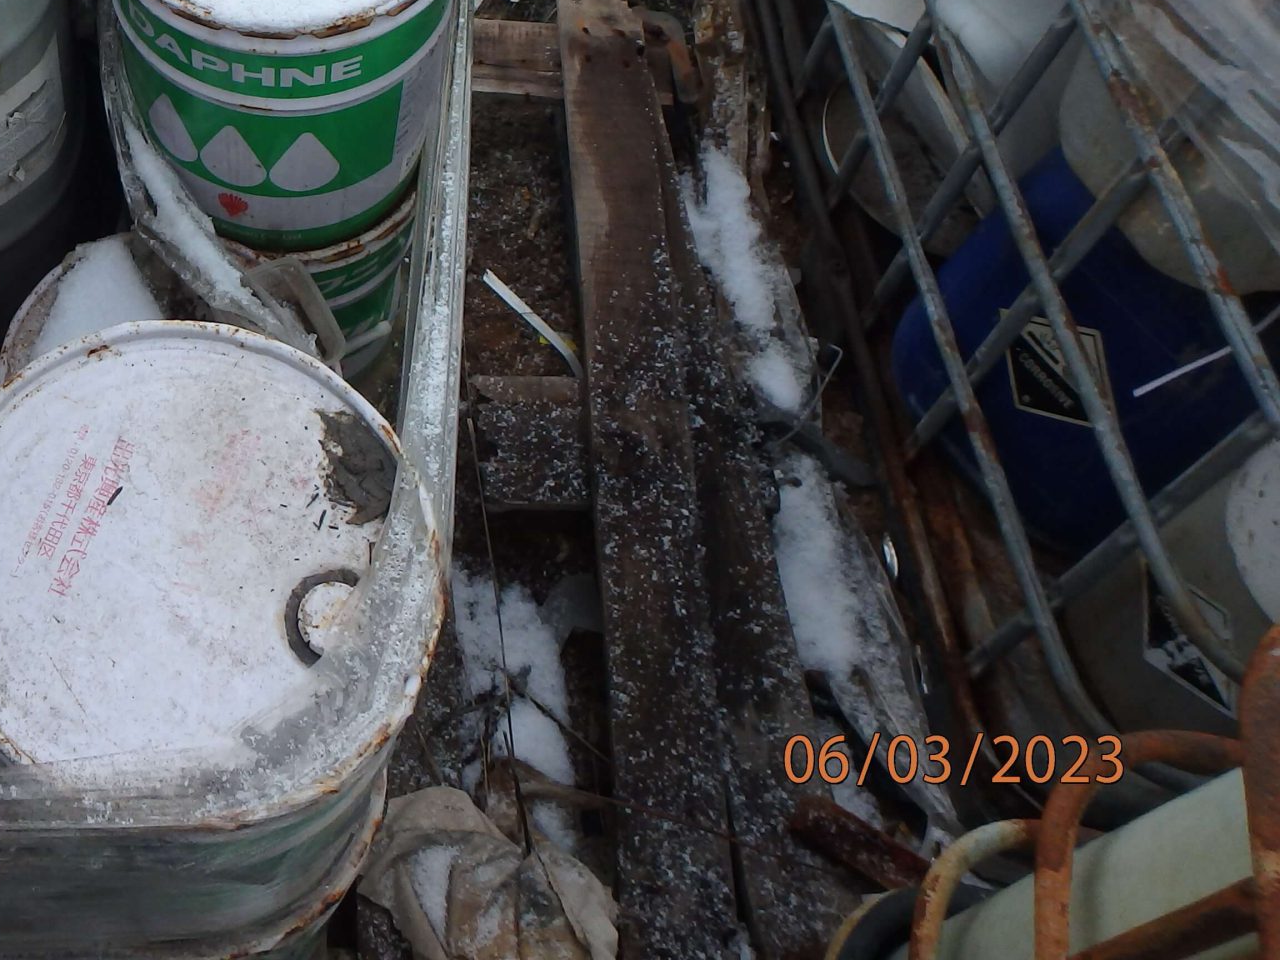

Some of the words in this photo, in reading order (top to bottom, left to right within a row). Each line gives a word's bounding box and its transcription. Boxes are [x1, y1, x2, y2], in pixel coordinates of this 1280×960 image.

[1020, 352, 1075, 409] CORROSIVE
[37, 453, 97, 560] 東京都千代田区
